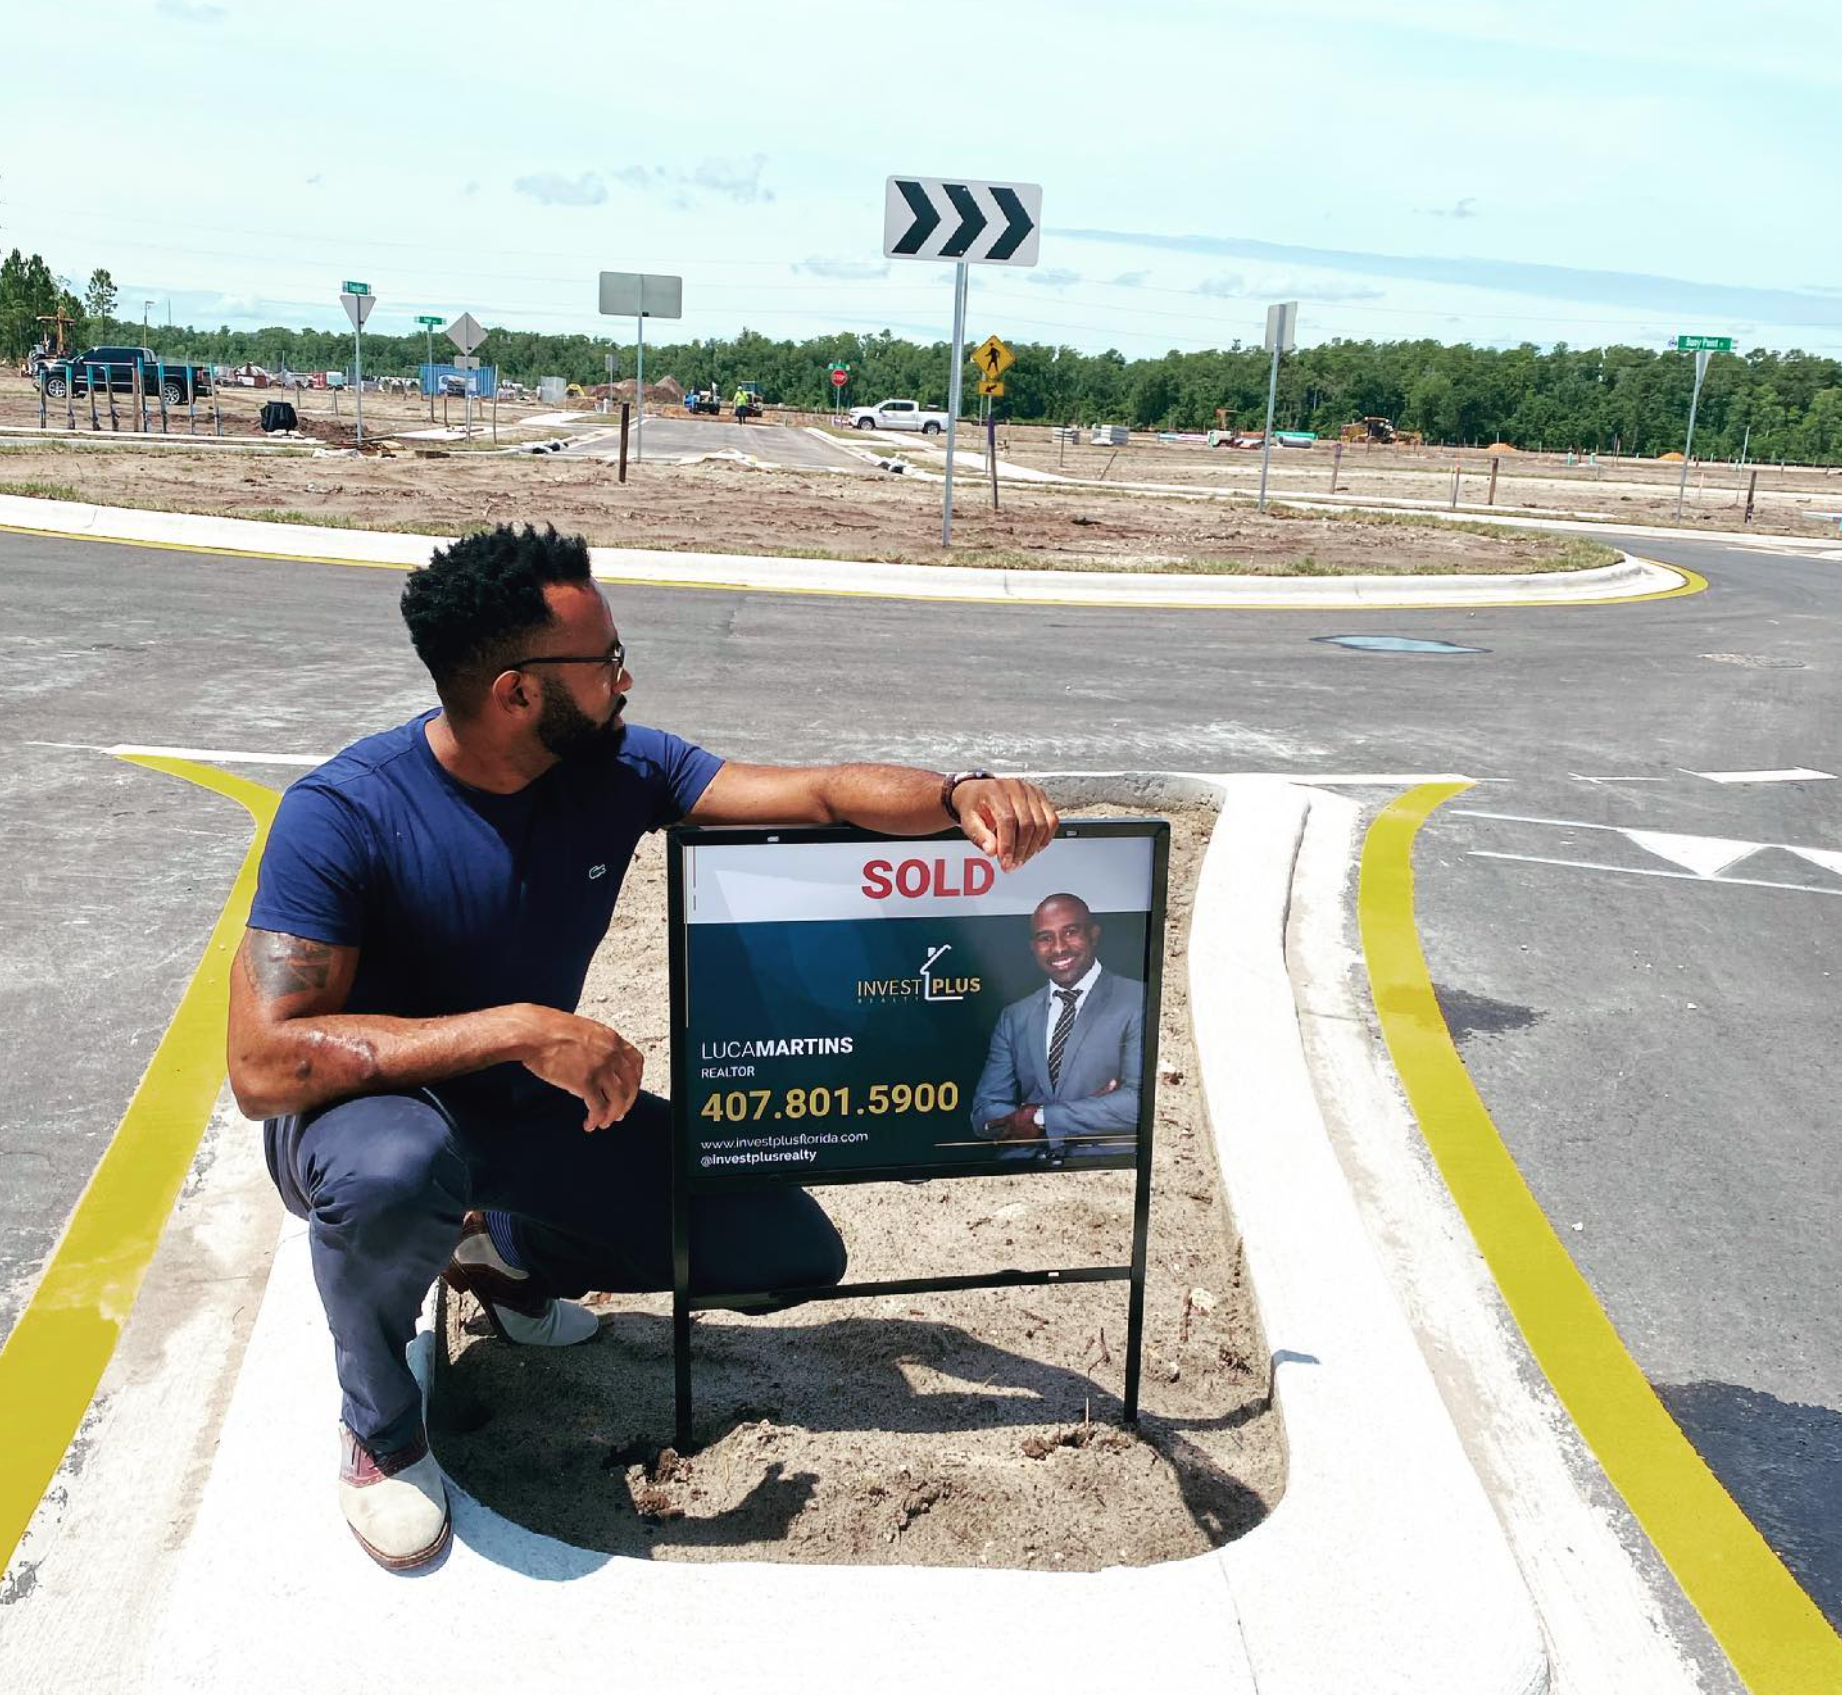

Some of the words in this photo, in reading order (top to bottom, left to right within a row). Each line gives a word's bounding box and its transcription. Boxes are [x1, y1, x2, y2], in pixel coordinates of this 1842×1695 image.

[861, 858, 995, 899] SOLD
[858, 979, 922, 997] INVEST
[932, 978, 981, 995] PLUS
[701, 1066, 755, 1079] REALTOR
[700, 1081, 959, 1122] 407.801.5900
[700, 1131, 869, 1149] www.investplusflorida.com
[700, 1149, 817, 1167] @investplusrealty
